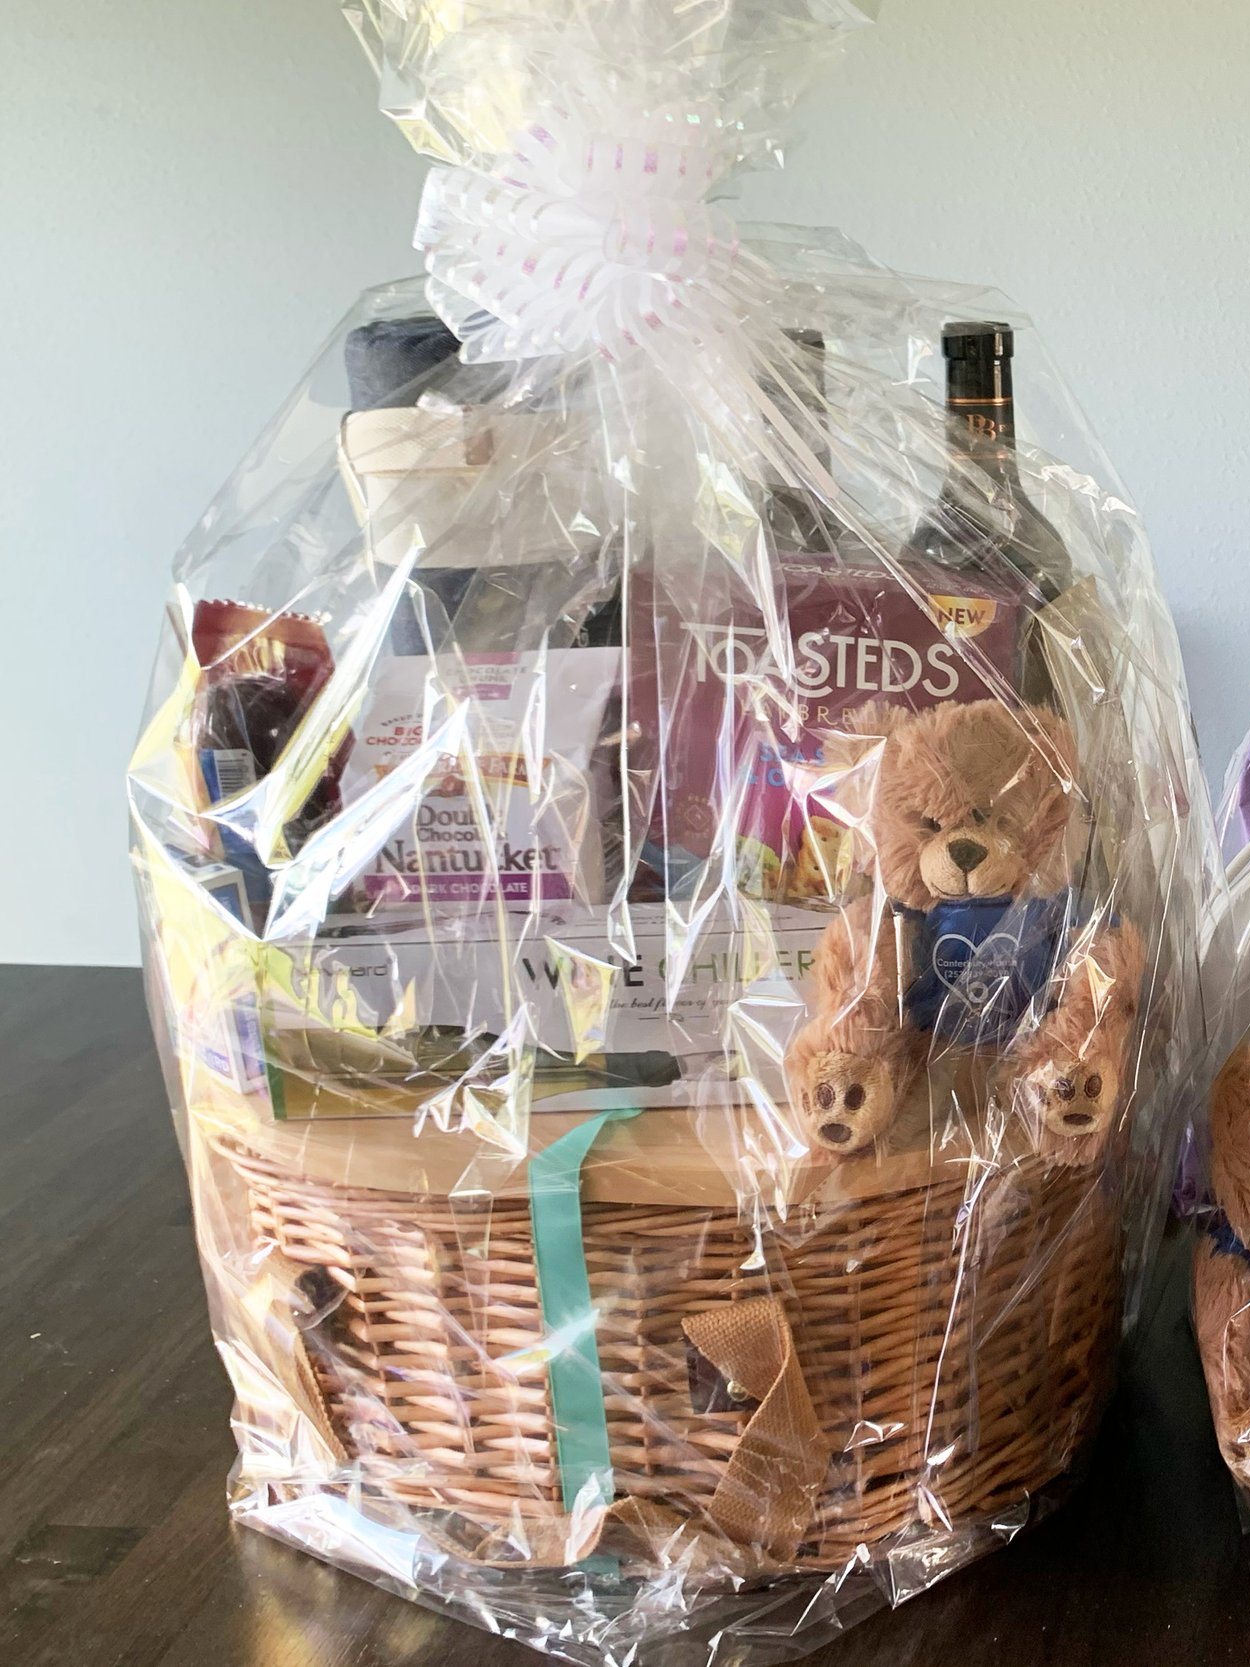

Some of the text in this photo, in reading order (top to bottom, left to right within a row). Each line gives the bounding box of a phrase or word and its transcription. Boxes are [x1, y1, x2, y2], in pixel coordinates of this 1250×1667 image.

[938, 607, 985, 625] NEW
[680, 622, 960, 698] TOASTEDS
[452, 882, 529, 894] CHOCOLATE
